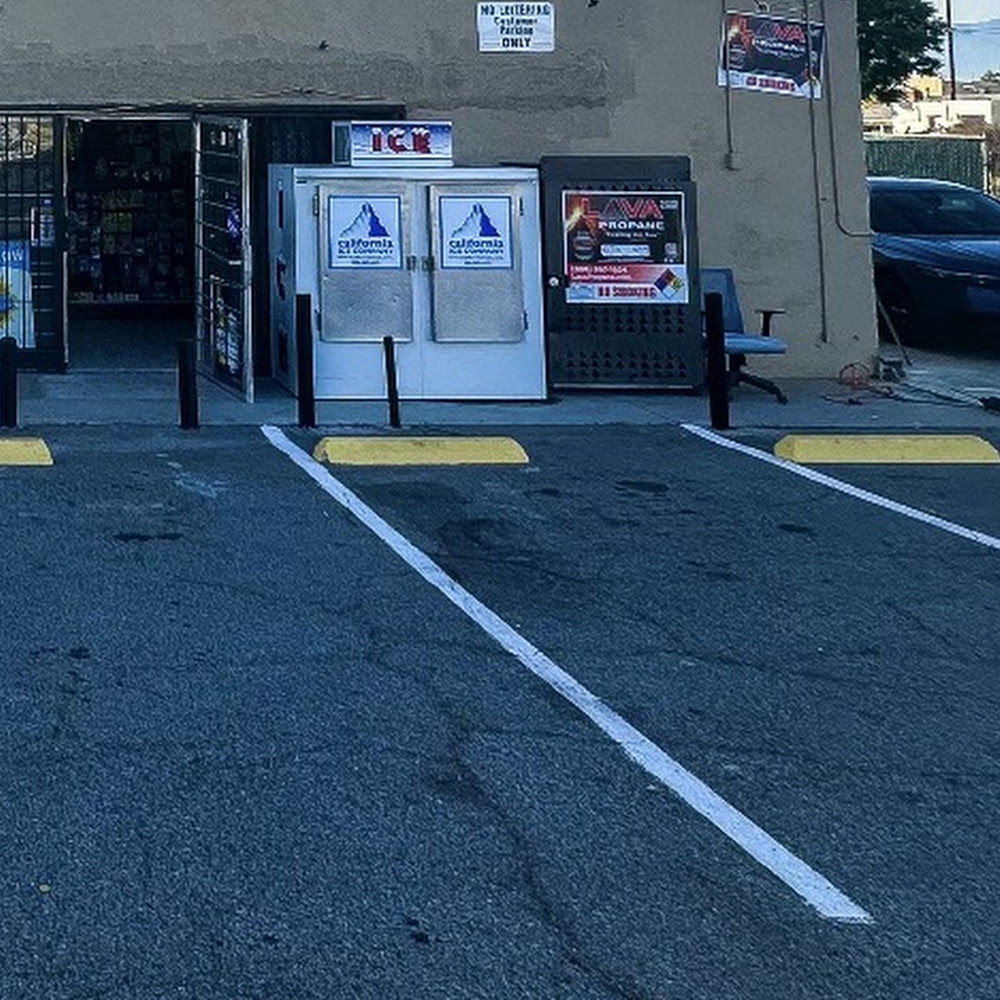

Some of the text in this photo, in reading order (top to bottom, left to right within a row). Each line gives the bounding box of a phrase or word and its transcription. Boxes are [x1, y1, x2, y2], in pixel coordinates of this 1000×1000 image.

[480, 4, 496, 16] NO
[501, 37, 531, 49] ONLY
[370, 126, 433, 155] ICE
[581, 197, 664, 220] LAVA
[598, 221, 665, 231] PROPANE
[338, 238, 395, 249] california
[448, 238, 504, 249] california
